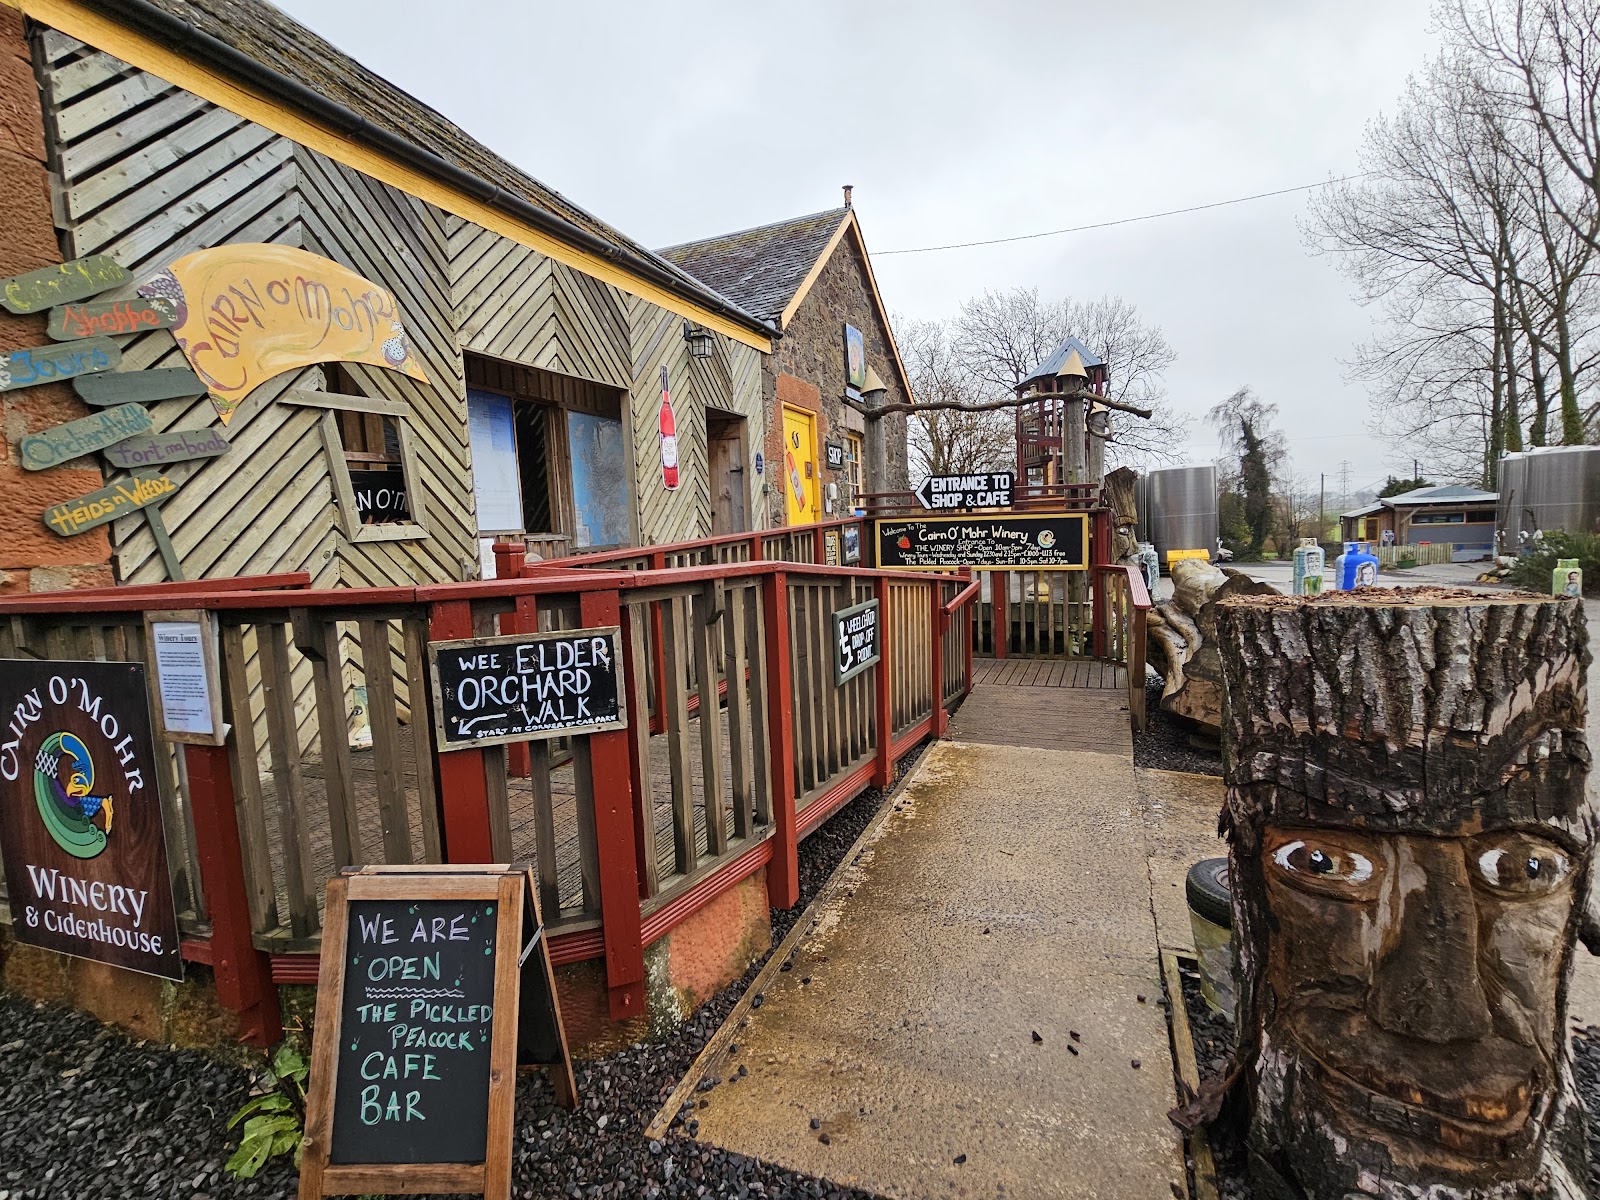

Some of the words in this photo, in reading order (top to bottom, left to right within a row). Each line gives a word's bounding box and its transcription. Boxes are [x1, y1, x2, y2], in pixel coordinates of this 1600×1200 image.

[63, 302, 161, 336] Shoppe
[190, 279, 265, 391] CAIRN
[11, 347, 109, 382] Tours
[828, 446, 842, 465] SHOP
[116, 476, 176, 506] WEEDZ
[931, 476, 988, 492] ENTRANCE
[992, 474, 1010, 490] TO
[357, 489, 372, 511] N
[931, 493, 963, 508] SHOP
[882, 527, 907, 537] Welcome
[919, 529, 947, 541] Cairn
[962, 526, 988, 539] Mohr
[991, 525, 1029, 544] Winery
[930, 544, 955, 552] WINERY
[956, 544, 974, 552] SHOP
[158, 634, 178, 642] Winery
[180, 634, 198, 642] Tours
[458, 653, 501, 671] WEE
[516, 637, 609, 674] ELDER
[458, 669, 592, 711] ORCHARD
[520, 696, 591, 726] WALK
[1, 687, 43, 781] CAIRN
[476, 728, 508, 738] START
[524, 721, 564, 732] CORNER
[594, 714, 616, 724] PARK
[25, 905, 39, 928] &
[359, 913, 400, 945] WE
[410, 913, 470, 943] ARE
[368, 951, 440, 981] OPEN
[356, 1003, 398, 1024] THE
[410, 998, 492, 1024] PICKLED
[388, 1023, 474, 1051] PEACOCK
[360, 1051, 441, 1081] CAFE
[360, 1084, 426, 1126] BAR
